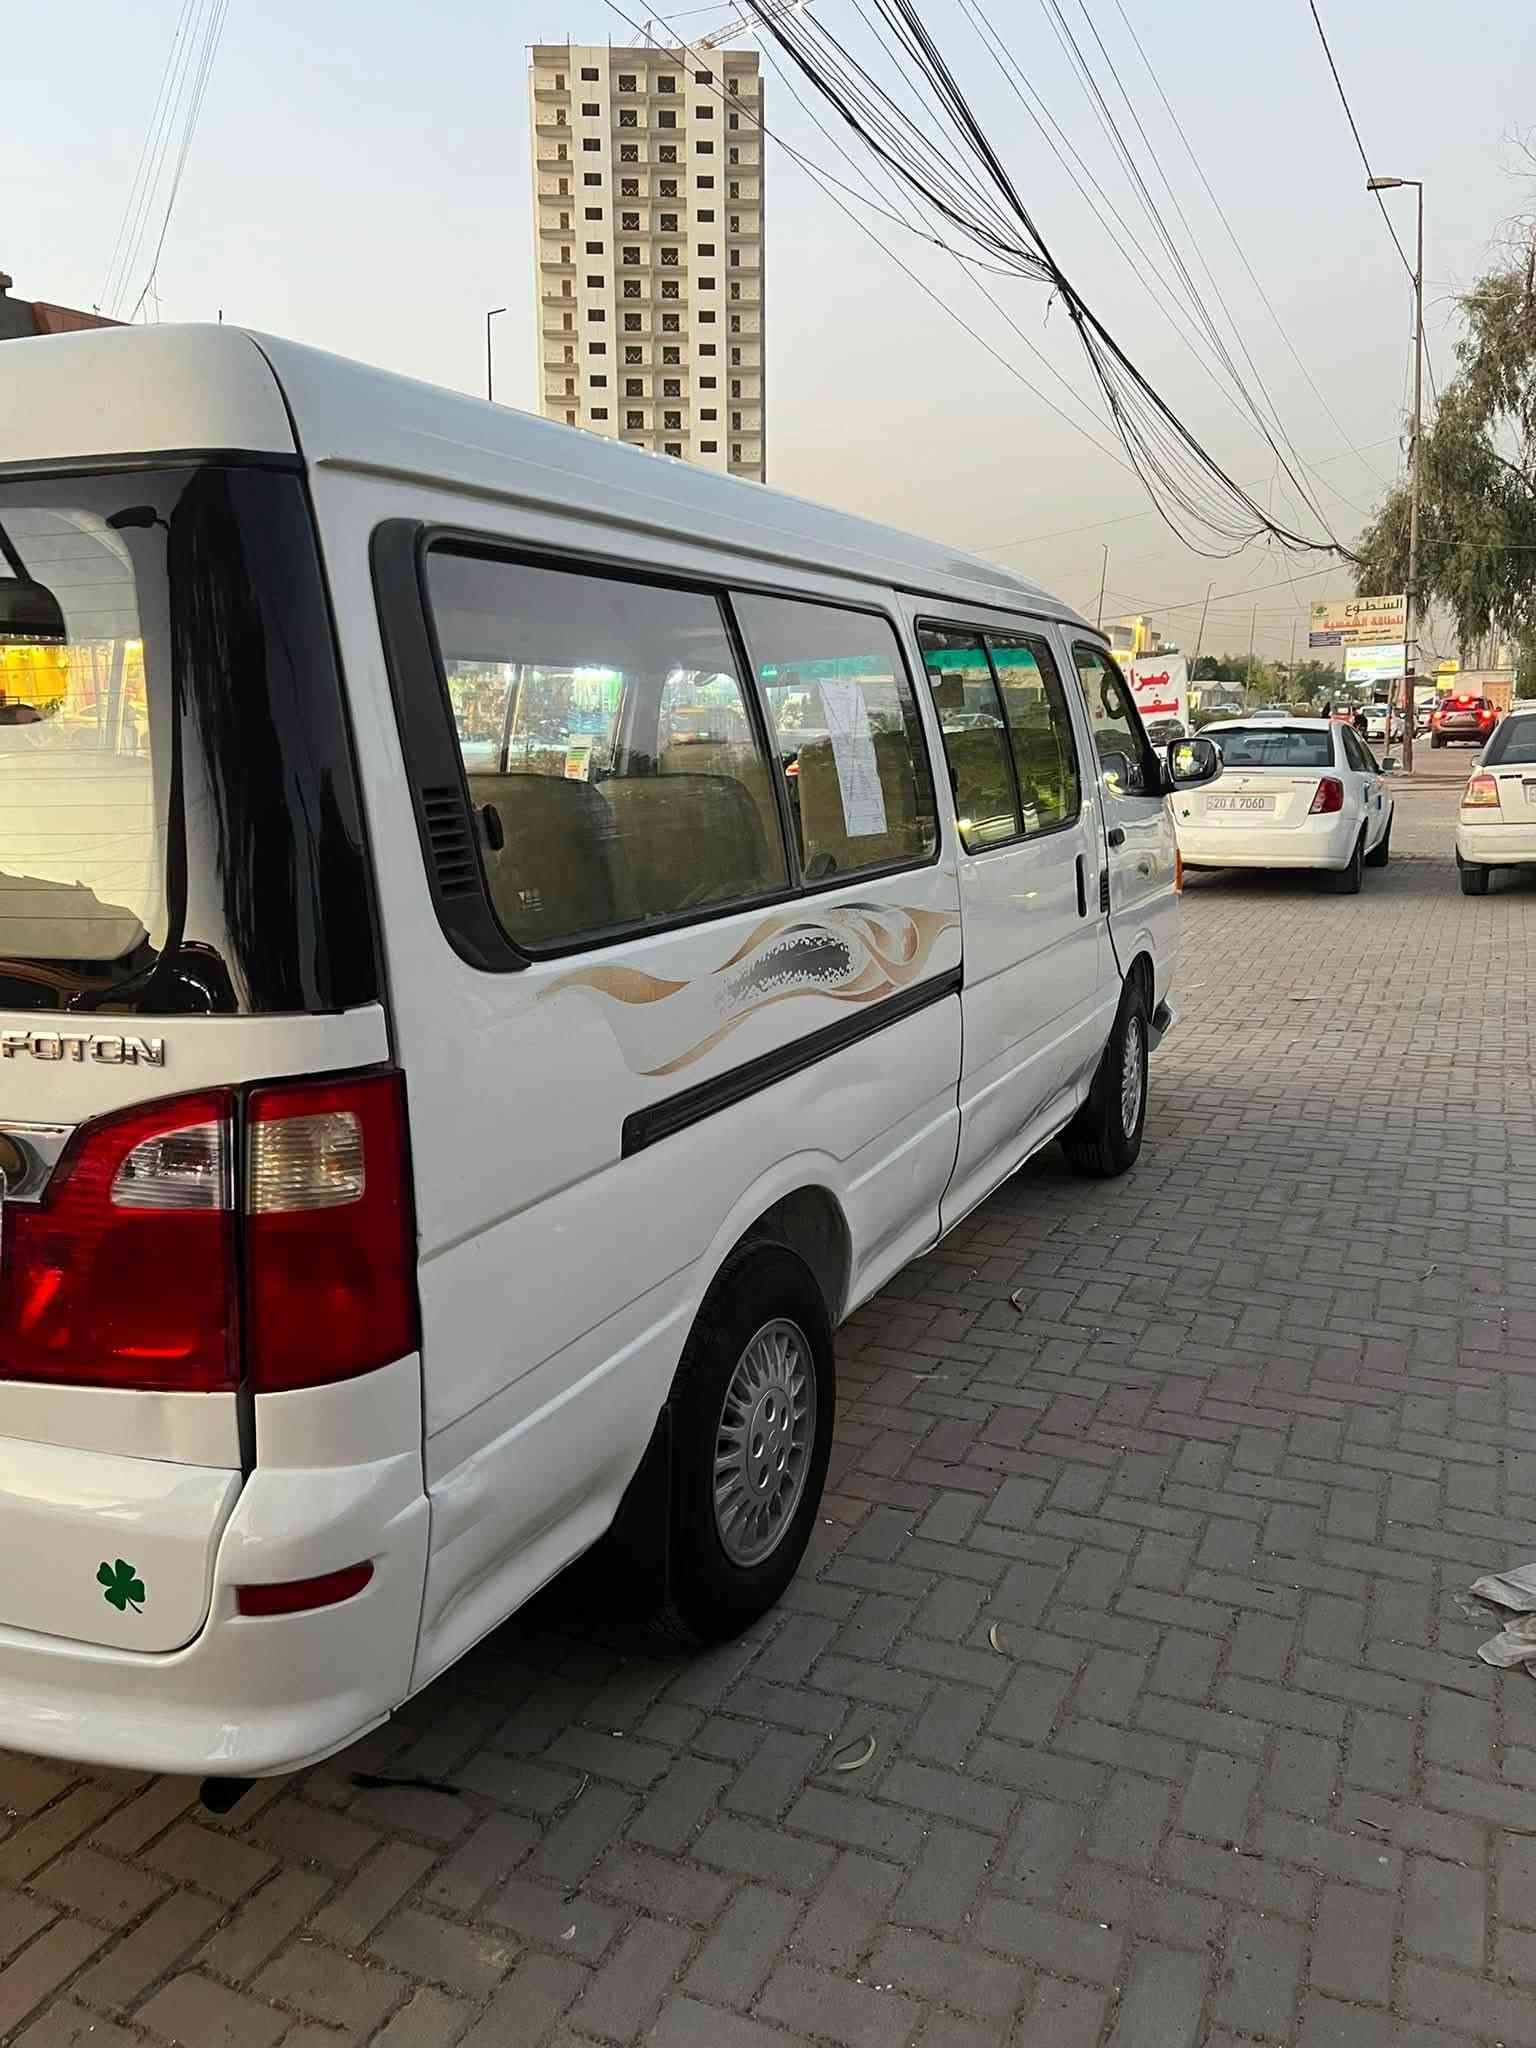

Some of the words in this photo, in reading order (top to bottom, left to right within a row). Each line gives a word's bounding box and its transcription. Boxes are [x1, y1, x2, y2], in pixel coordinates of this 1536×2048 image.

[1344, 598, 1403, 617] السطوع
[1123, 667, 1170, 692] ميزا
[1214, 798, 1226, 809] 20
[1229, 798, 1236, 809] A
[1, 1030, 165, 1068] FOTON
